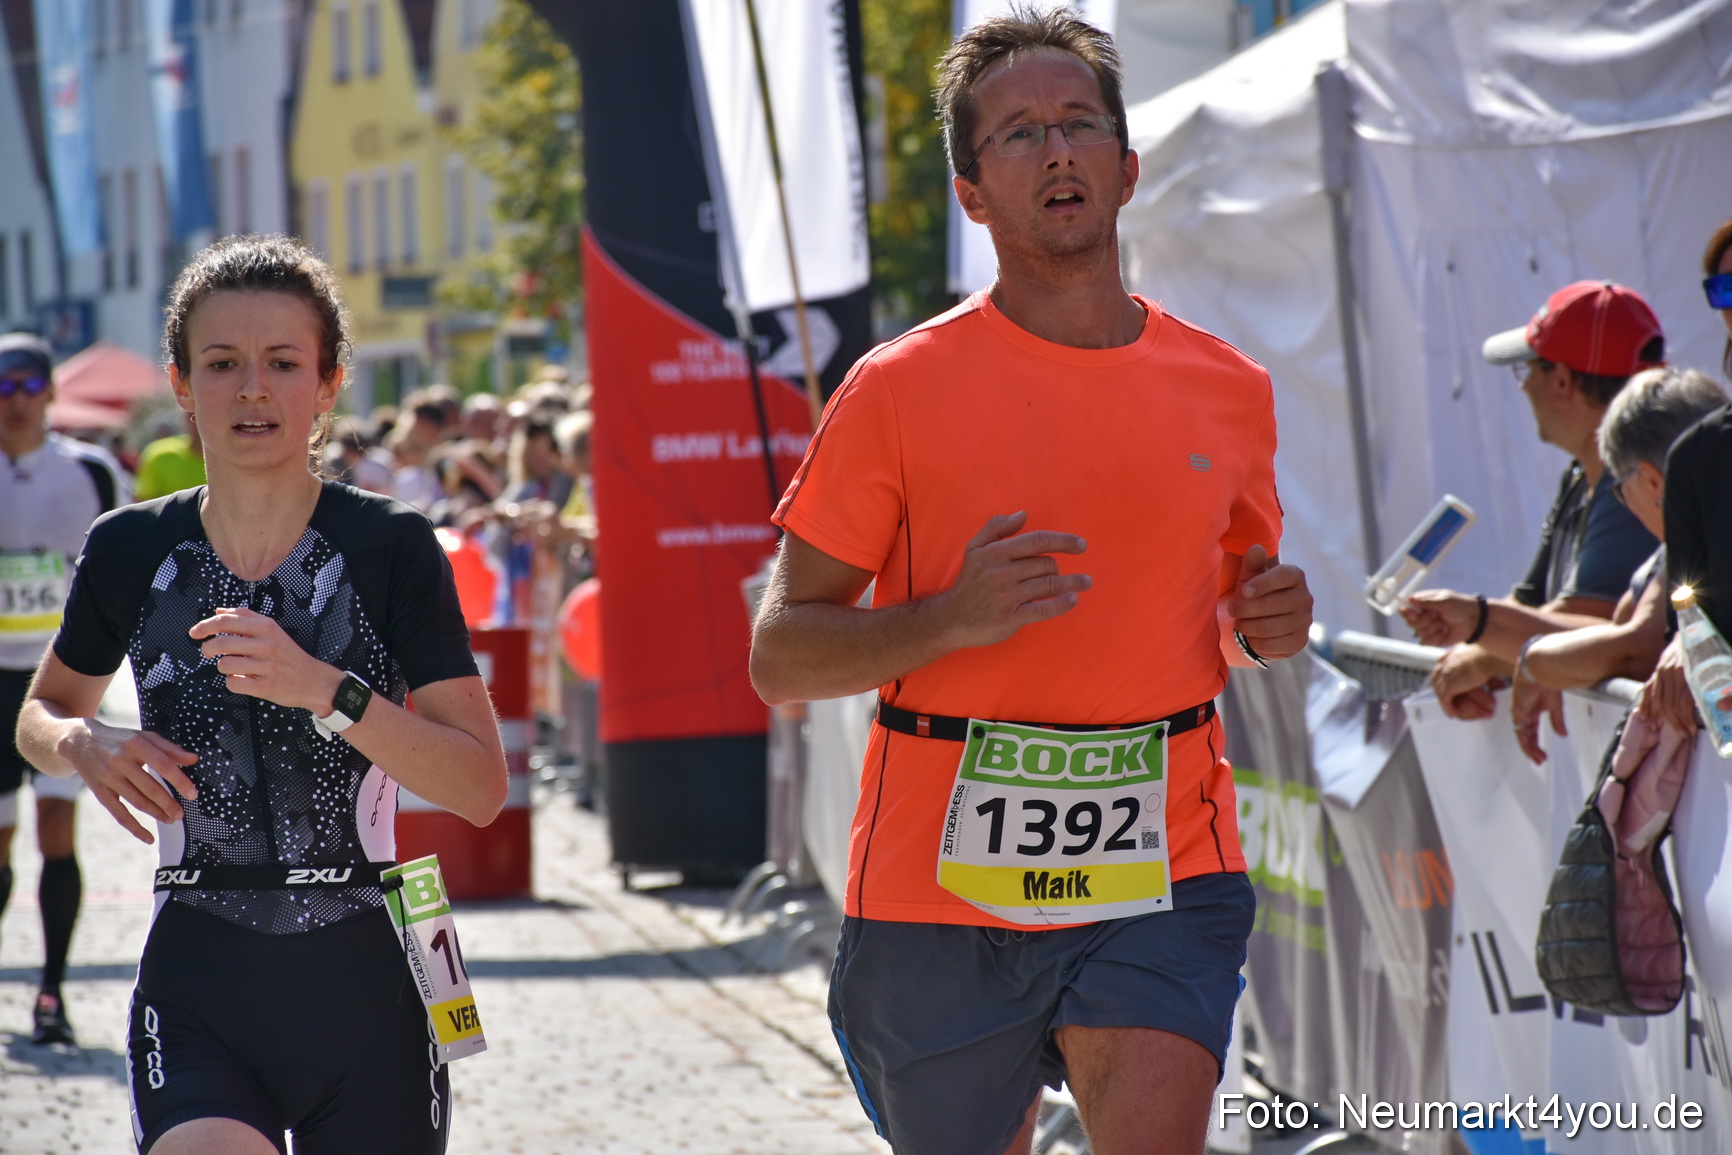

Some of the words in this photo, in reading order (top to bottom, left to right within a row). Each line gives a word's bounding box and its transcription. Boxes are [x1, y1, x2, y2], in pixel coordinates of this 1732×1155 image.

[652, 433, 722, 462] BMW
[976, 732, 1151, 782] BOCK
[976, 796, 1140, 856] 1392
[155, 870, 201, 886] 2XU
[285, 868, 352, 885] 2XU
[403, 868, 448, 911] B
[1023, 870, 1092, 900] Maik
[145, 1005, 164, 1089] orca
